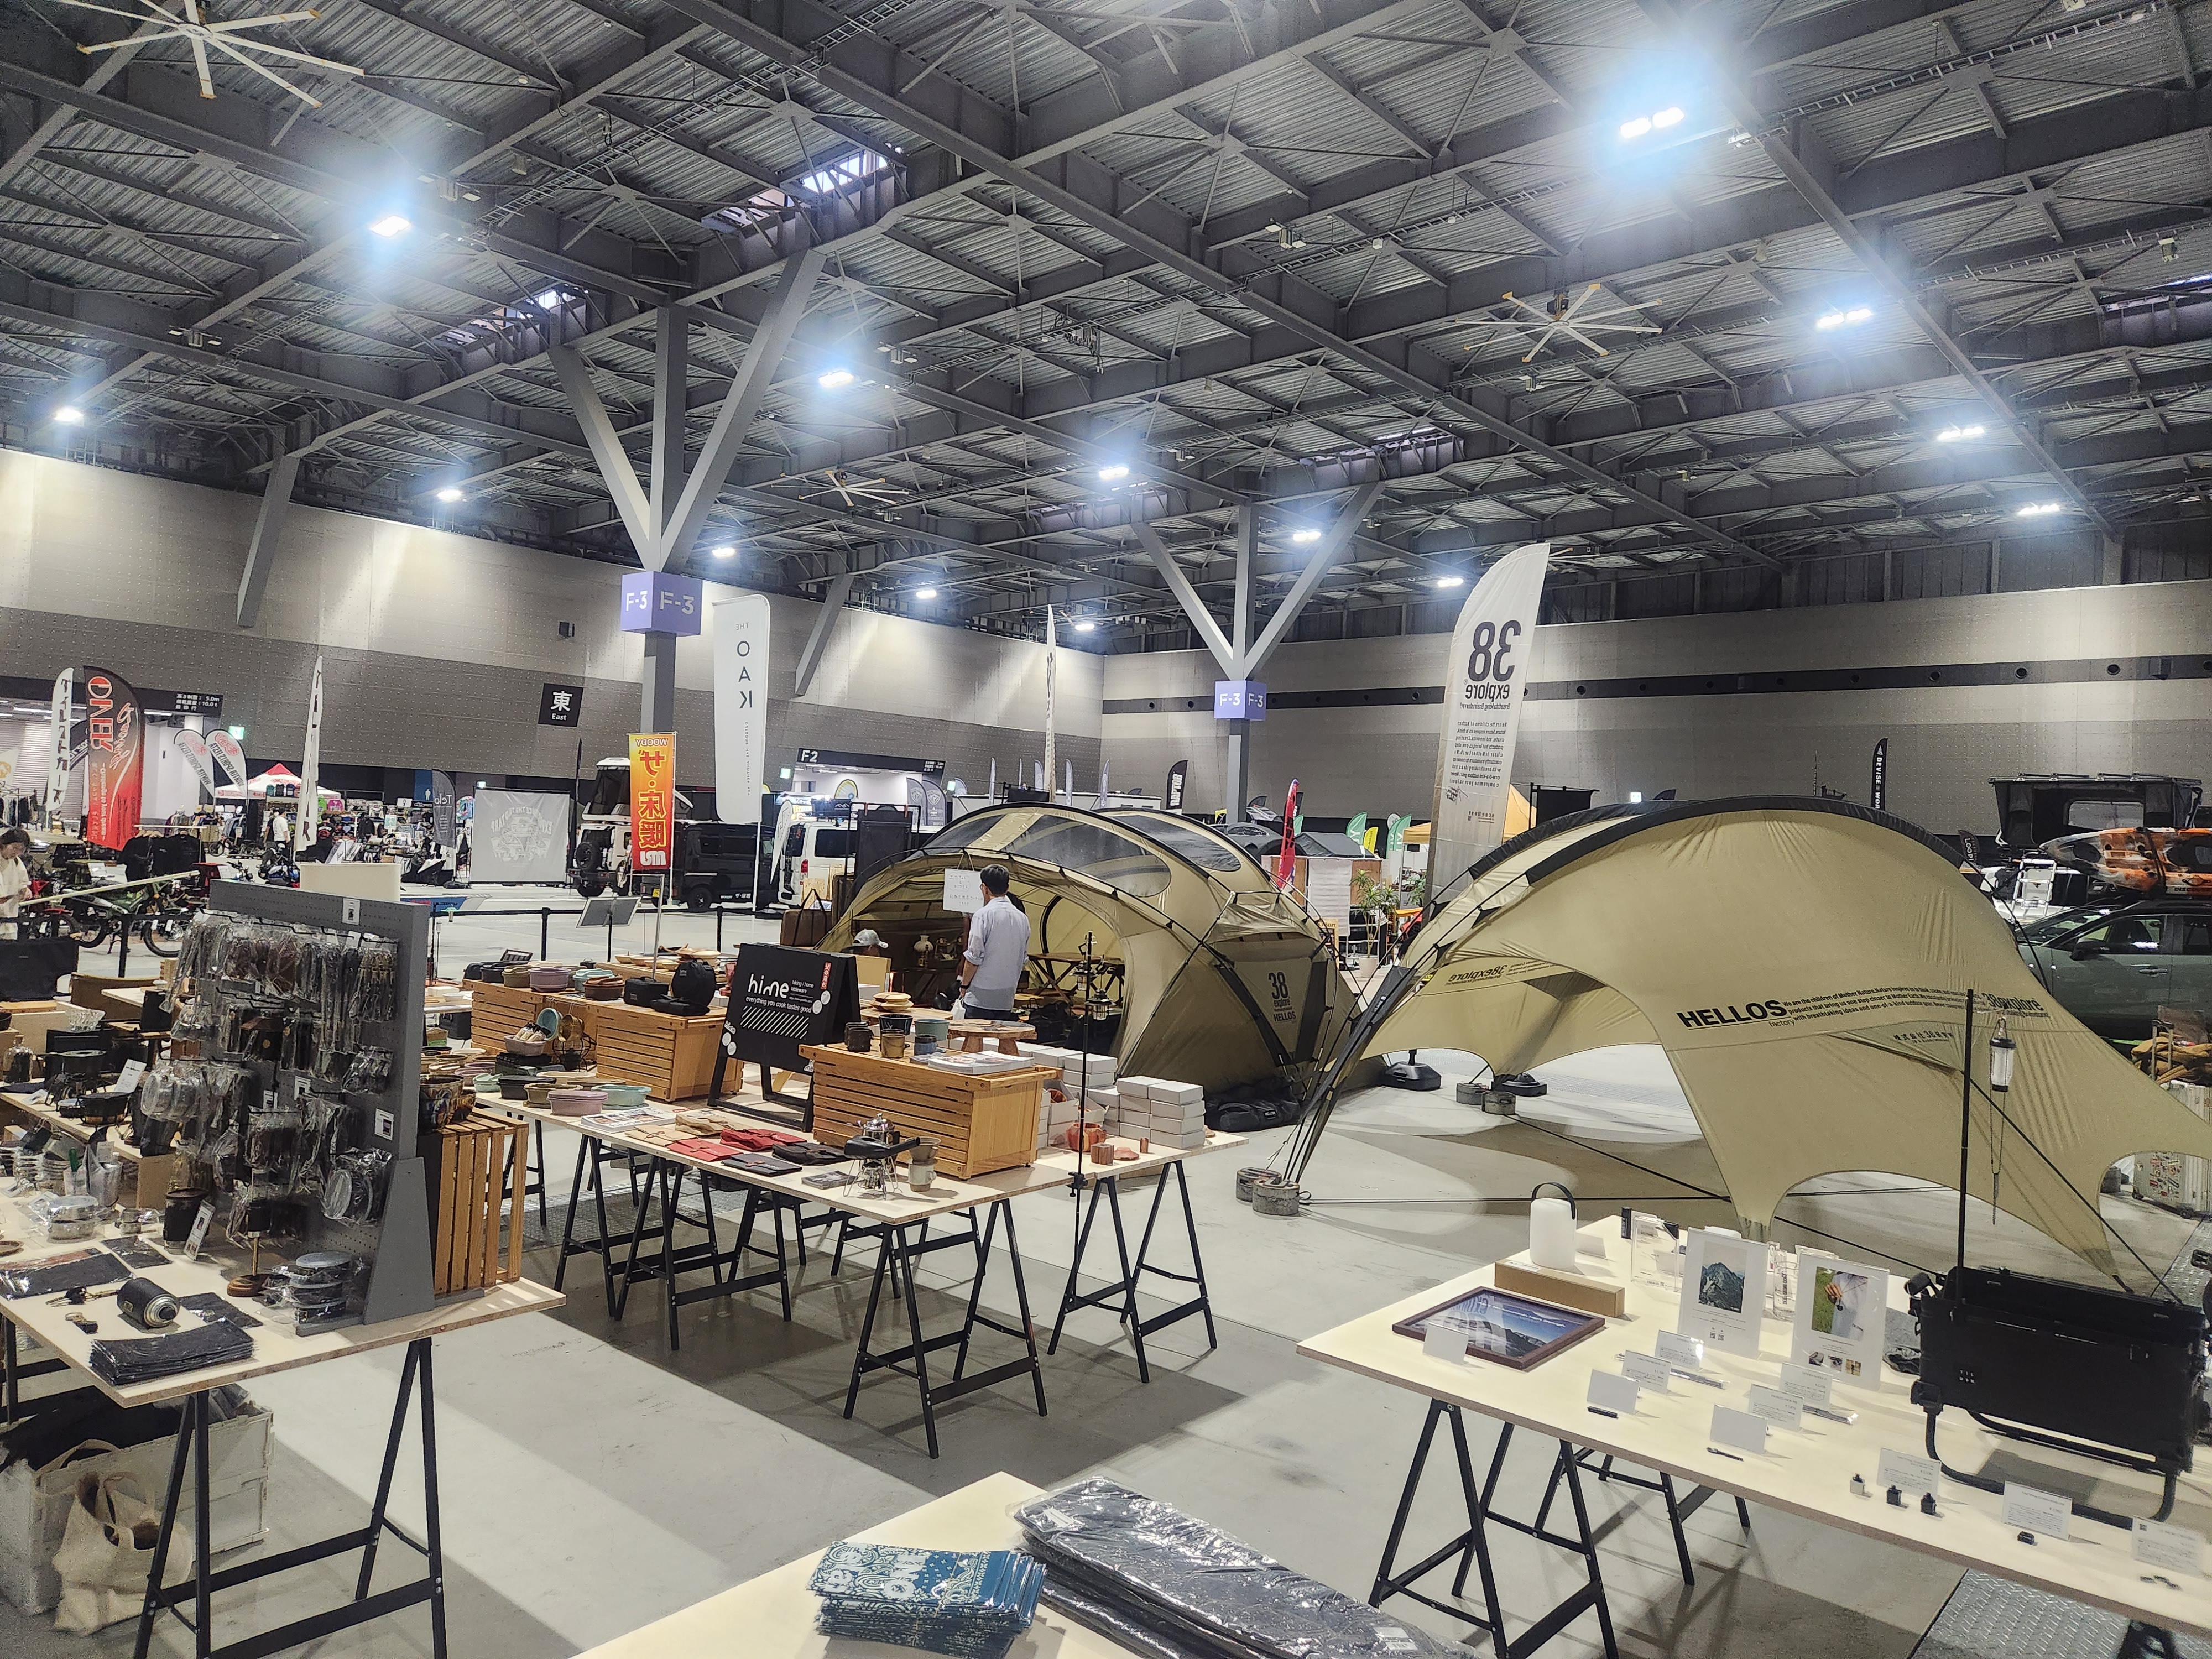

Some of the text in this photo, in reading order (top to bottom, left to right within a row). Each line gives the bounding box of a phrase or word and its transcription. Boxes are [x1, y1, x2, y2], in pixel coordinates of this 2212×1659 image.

[626, 590, 648, 612] F-3
[660, 591, 694, 614] F-3
[550, 691, 573, 711] 東
[1219, 693, 1240, 706] F-3
[1248, 693, 1264, 708] F-3
[801, 750, 818, 763] F2
[1170, 773, 1183, 806] RAPTOR
[1268, 971, 1289, 999] 38
[746, 996, 767, 1006] everything
[775, 1000, 786, 1009] cook
[786, 1003, 800, 1011] tastes
[800, 1005, 812, 1014] good
[1274, 997, 1291, 1007] explore
[1782, 1000, 1792, 1008] We
[1801, 997, 1811, 1006] the
[1811, 994, 1833, 1003] children
[1838, 990, 1858, 999] Mother
[1677, 1000, 1787, 1027] HELLOS
[1788, 1005, 1813, 1015] products
[1813, 1002, 1825, 1011] that
[1825, 1000, 1839, 1010] bring
[1793, 1013, 1807, 1021] with
[1807, 1009, 1843, 1020] breathtaking
[1843, 1006, 1858, 1015] ideas
[1274, 1011, 1296, 1022] HELLOS
[1769, 1018, 1795, 1028] factory
